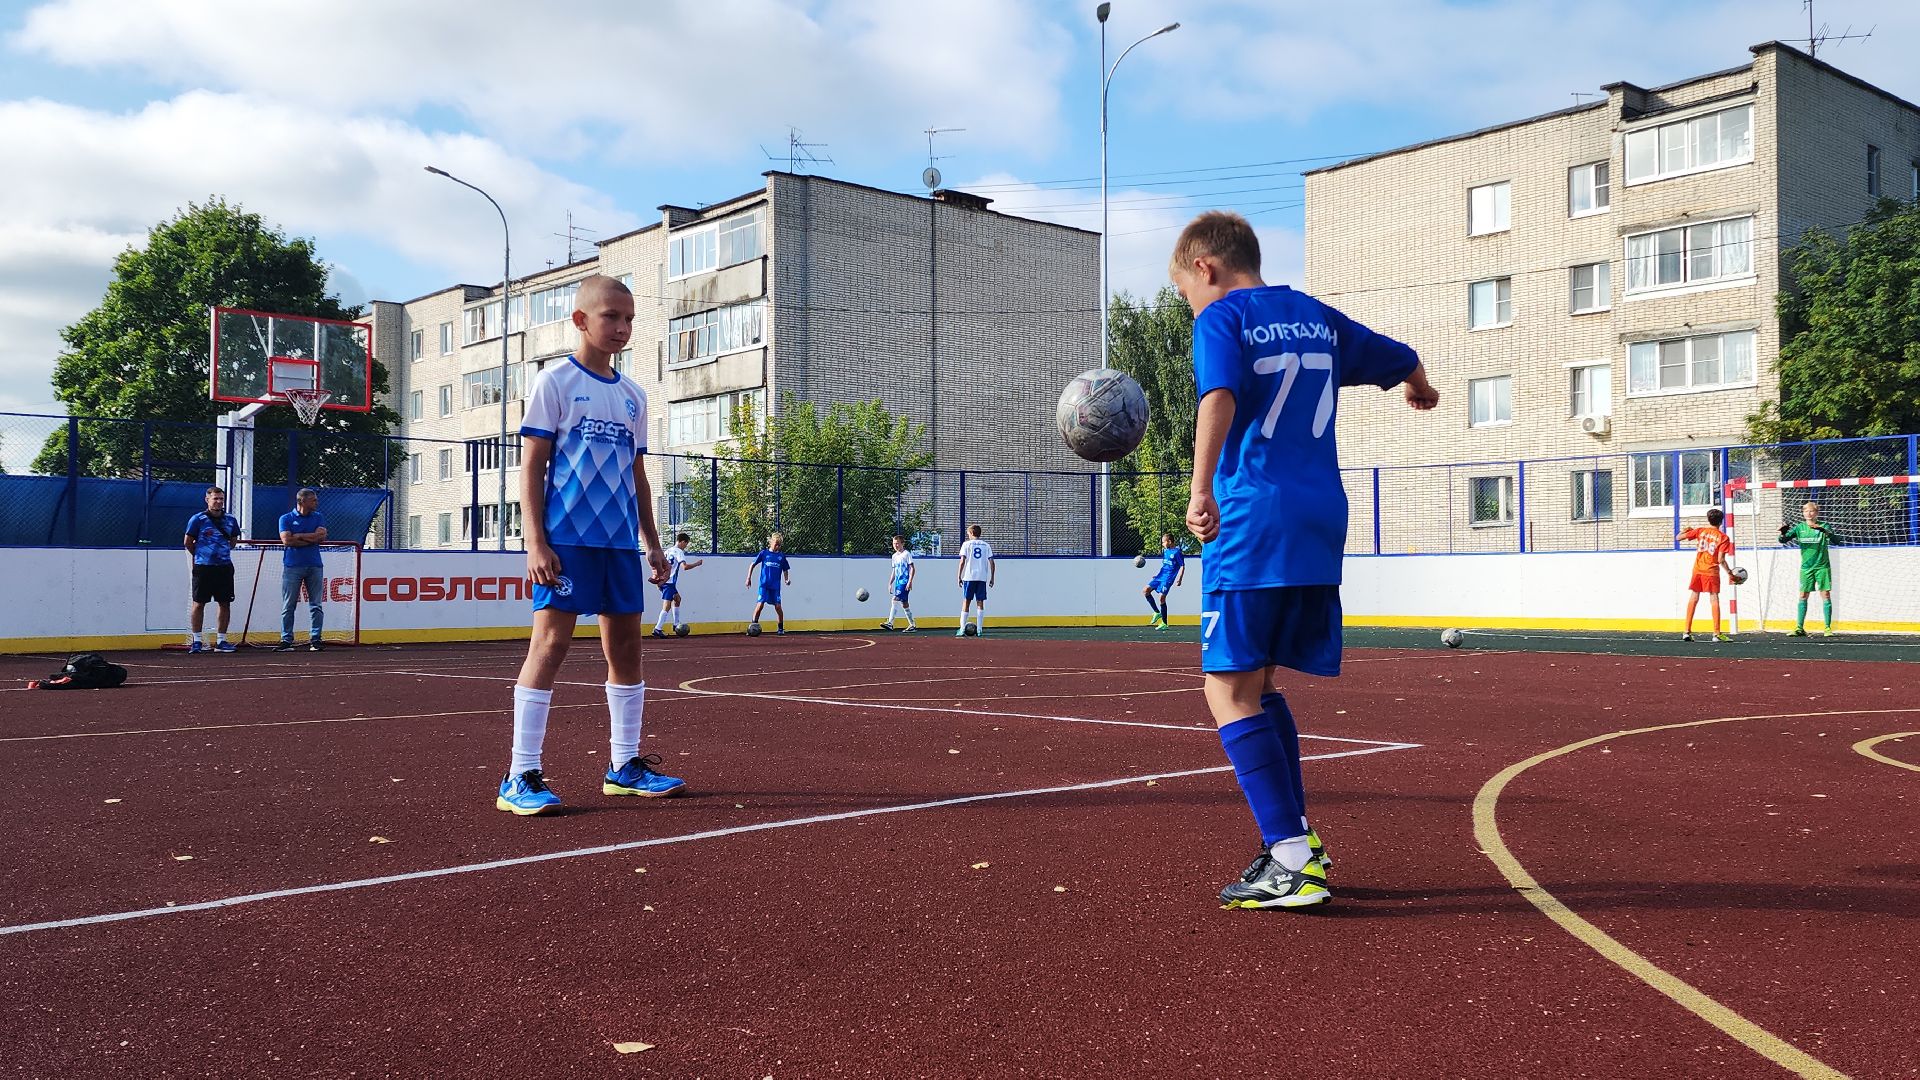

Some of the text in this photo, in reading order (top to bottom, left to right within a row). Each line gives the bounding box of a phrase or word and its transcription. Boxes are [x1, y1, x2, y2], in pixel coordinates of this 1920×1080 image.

[1253, 352, 1334, 439] 77
[973, 547, 982, 559] 8
[1202, 610, 1221, 639] 7
